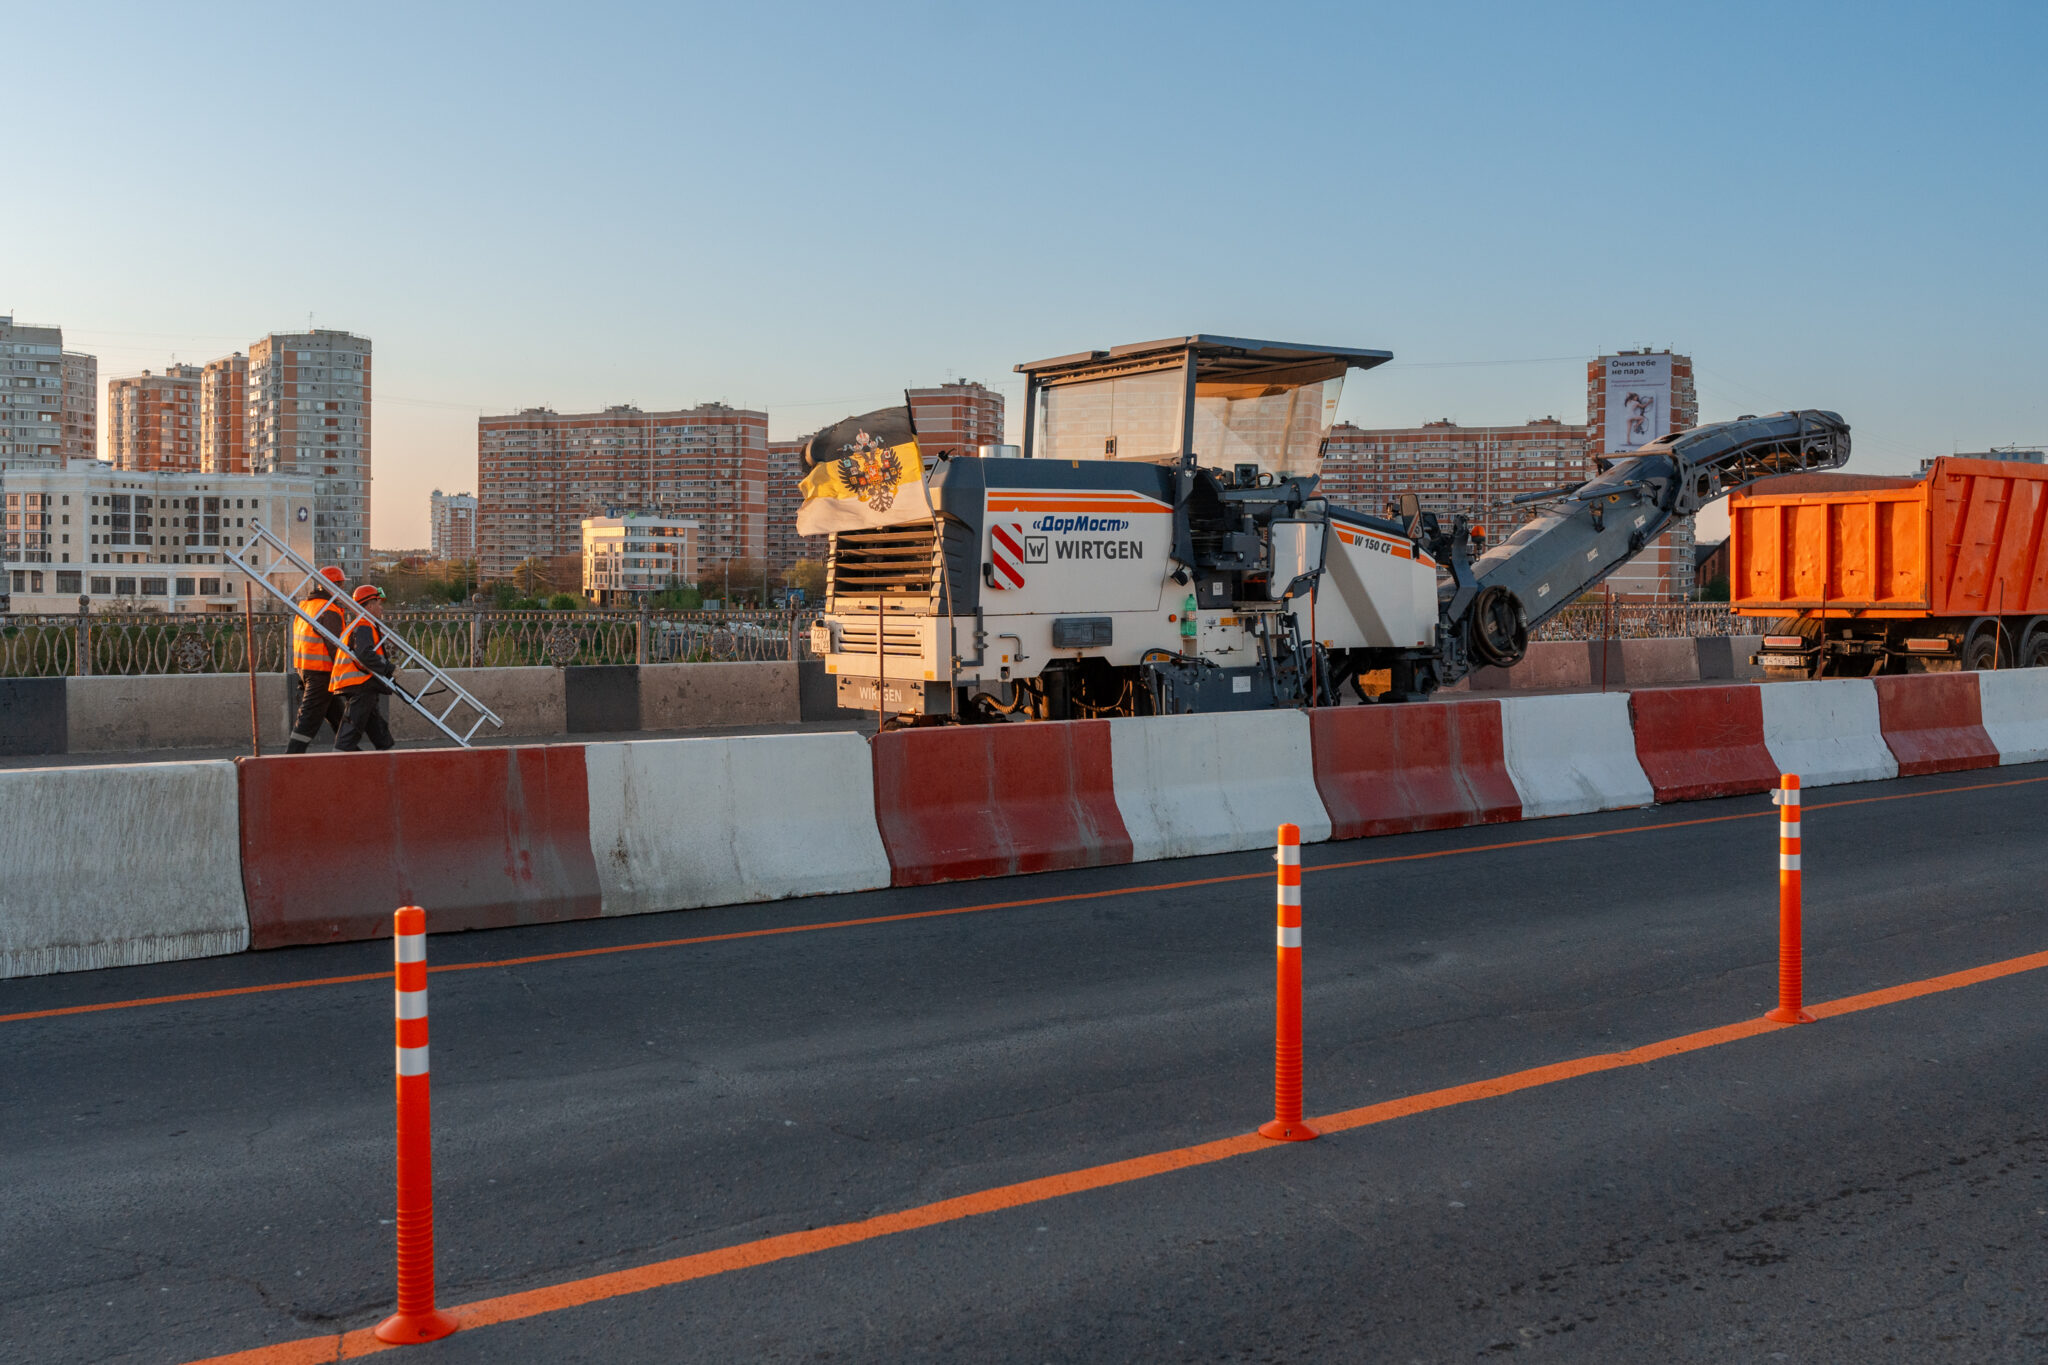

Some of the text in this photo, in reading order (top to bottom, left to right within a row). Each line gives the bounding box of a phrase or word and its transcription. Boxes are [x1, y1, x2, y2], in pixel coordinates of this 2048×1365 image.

[1611, 360, 1635, 368] Очки
[1623, 368, 1645, 376] пара
[1354, 534, 1392, 553] W 150 CF
[1055, 540, 1143, 560] WIRTGEN
[813, 629, 828, 639] 7237
